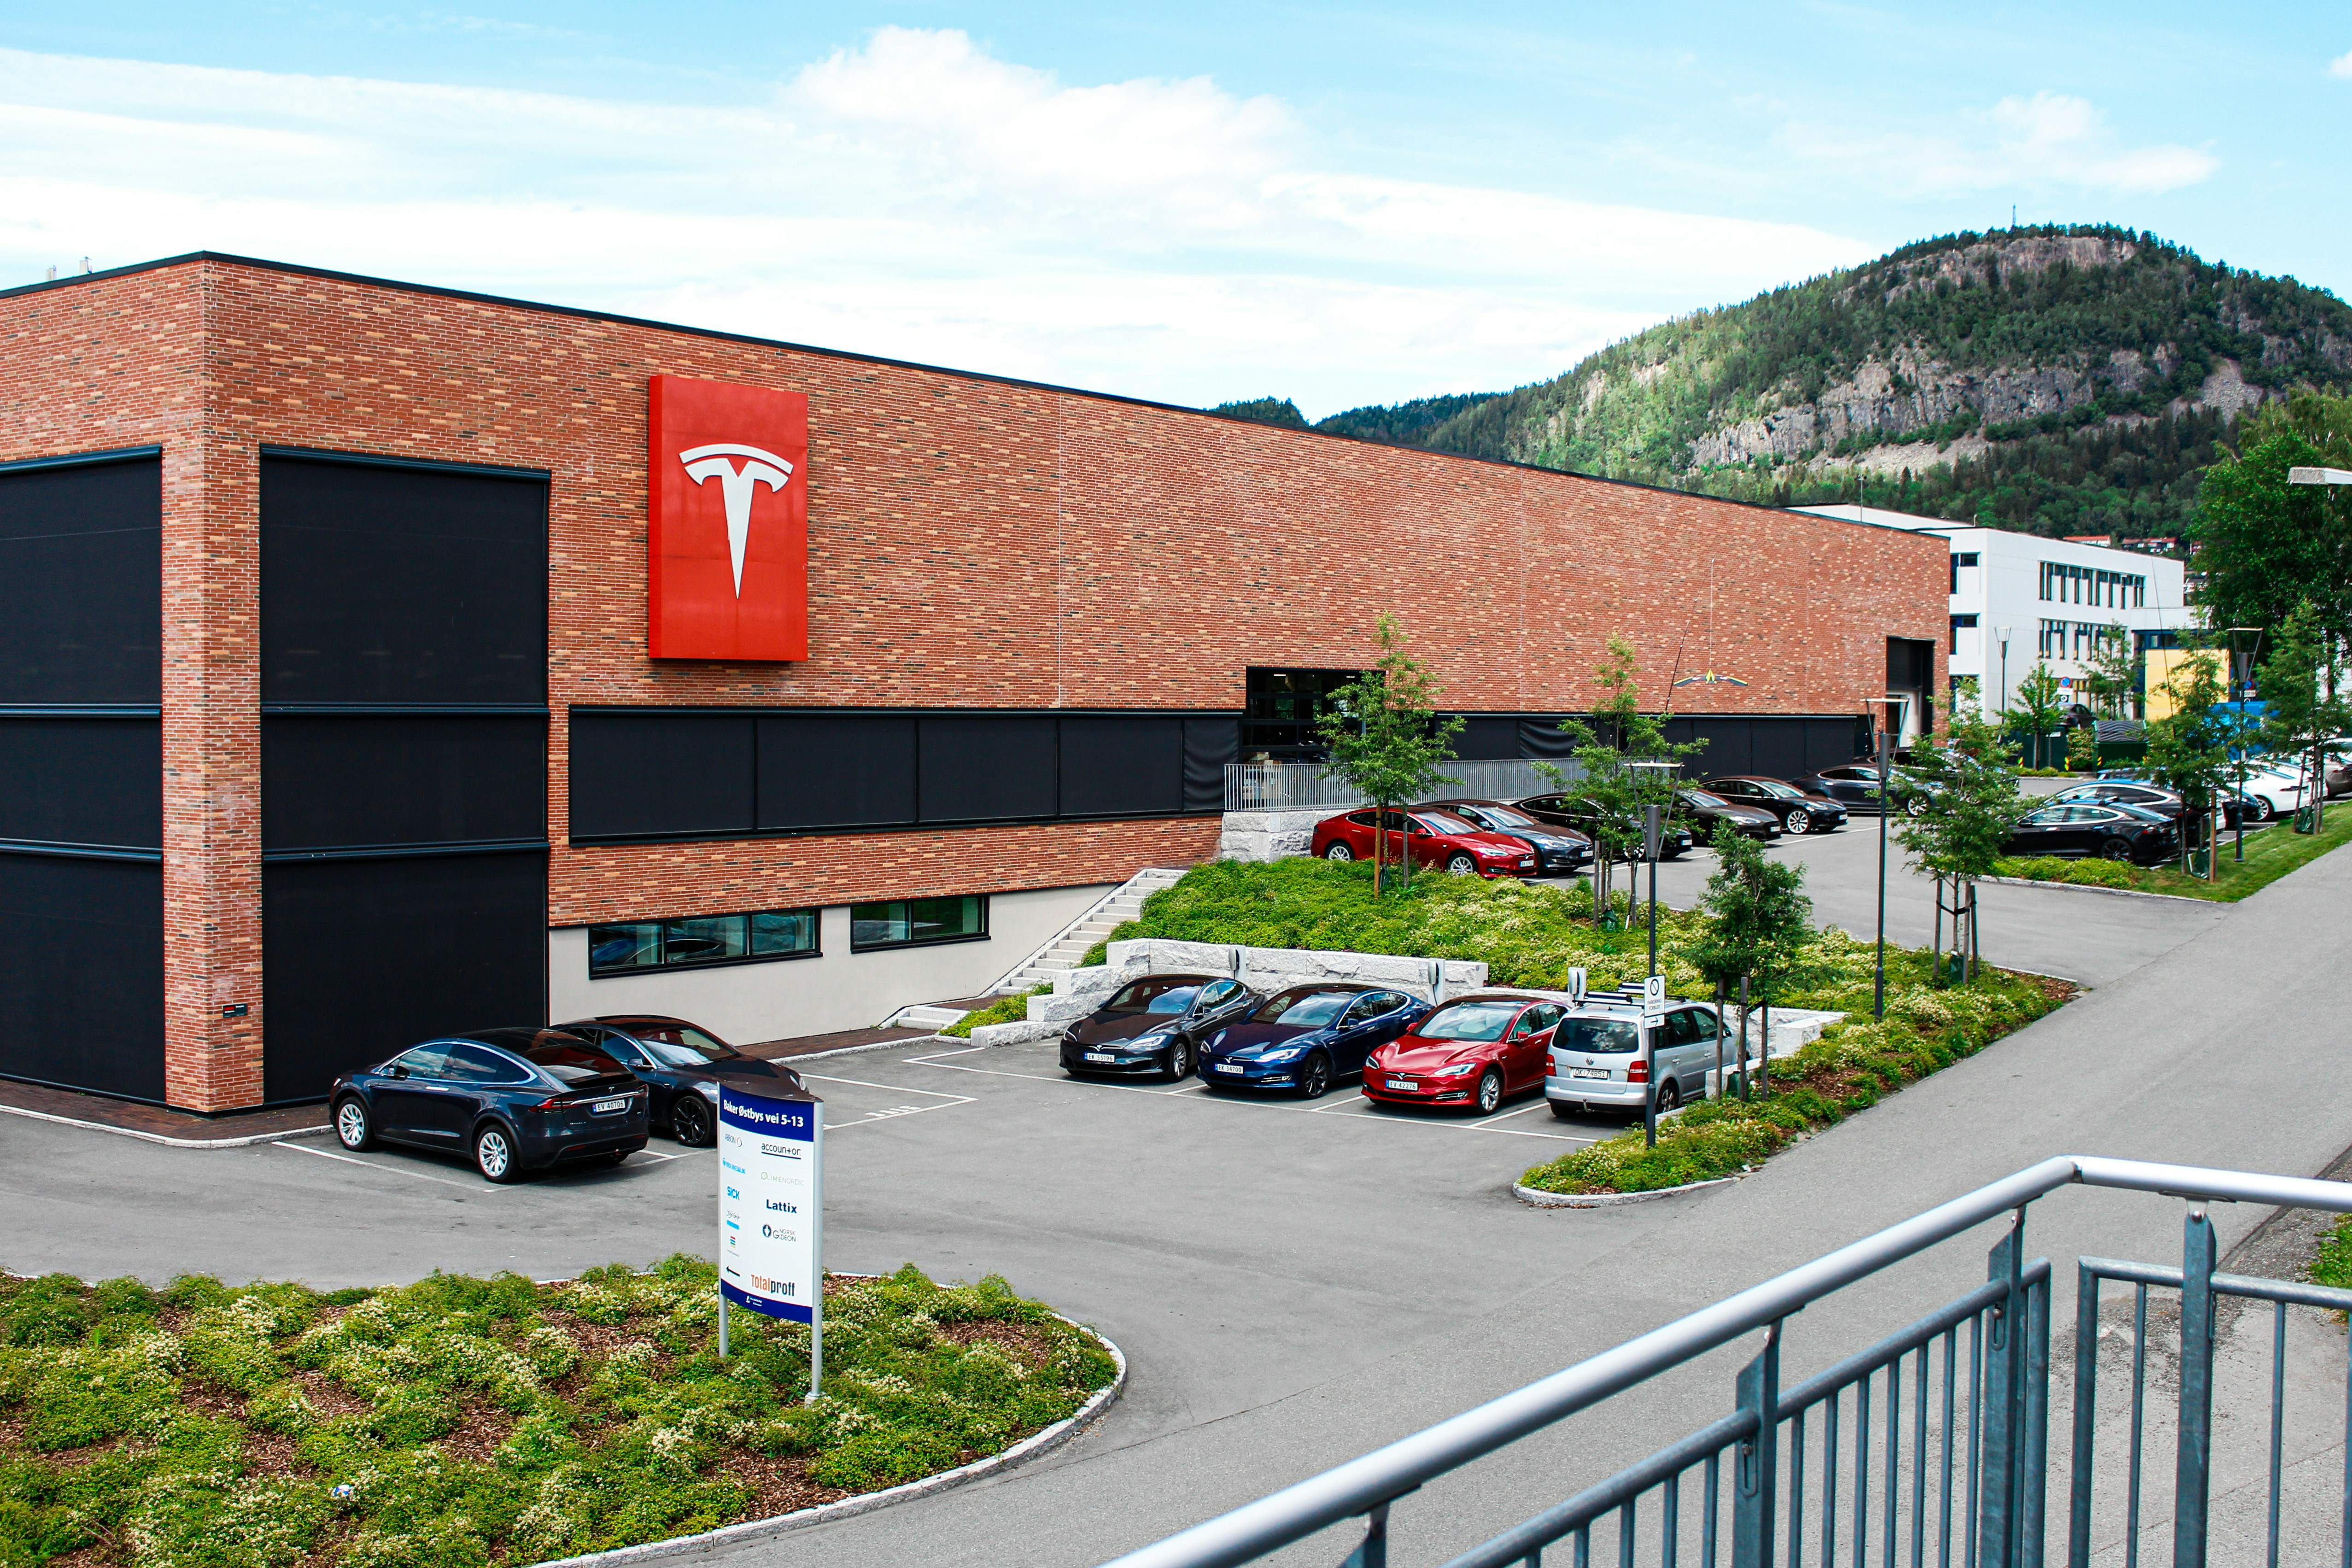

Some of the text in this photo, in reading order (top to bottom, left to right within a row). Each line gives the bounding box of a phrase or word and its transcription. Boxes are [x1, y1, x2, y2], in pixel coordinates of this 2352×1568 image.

[607, 1100, 624, 1109] 40706
[724, 1099, 804, 1128] Baker Østbys vei 5-13
[727, 1186, 740, 1200] SICK
[766, 1199, 797, 1214] Lattix
[772, 1230, 796, 1242] GIDEON
